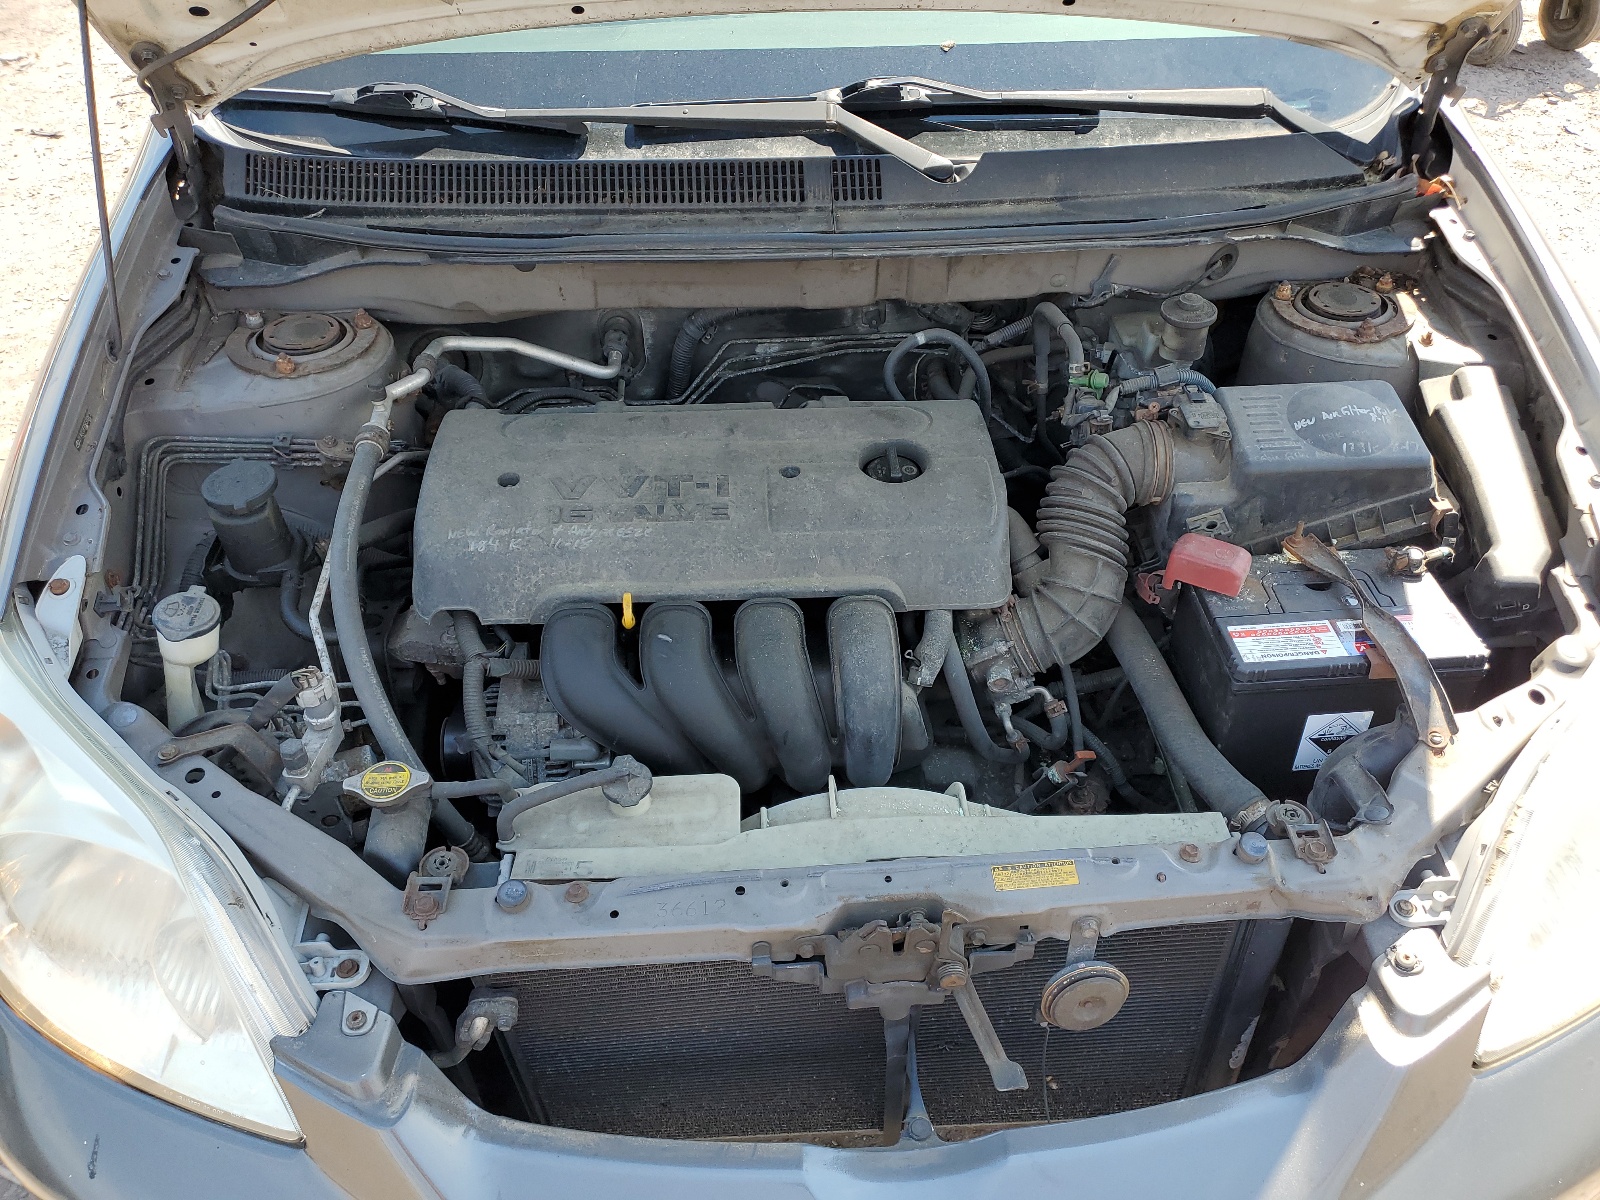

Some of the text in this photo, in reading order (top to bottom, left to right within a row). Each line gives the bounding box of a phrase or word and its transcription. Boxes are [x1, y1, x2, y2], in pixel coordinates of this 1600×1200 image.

[369, 786, 398, 794] CAUTION
[1015, 863, 1041, 871] CAUTION
[656, 899, 726, 918] 36612
